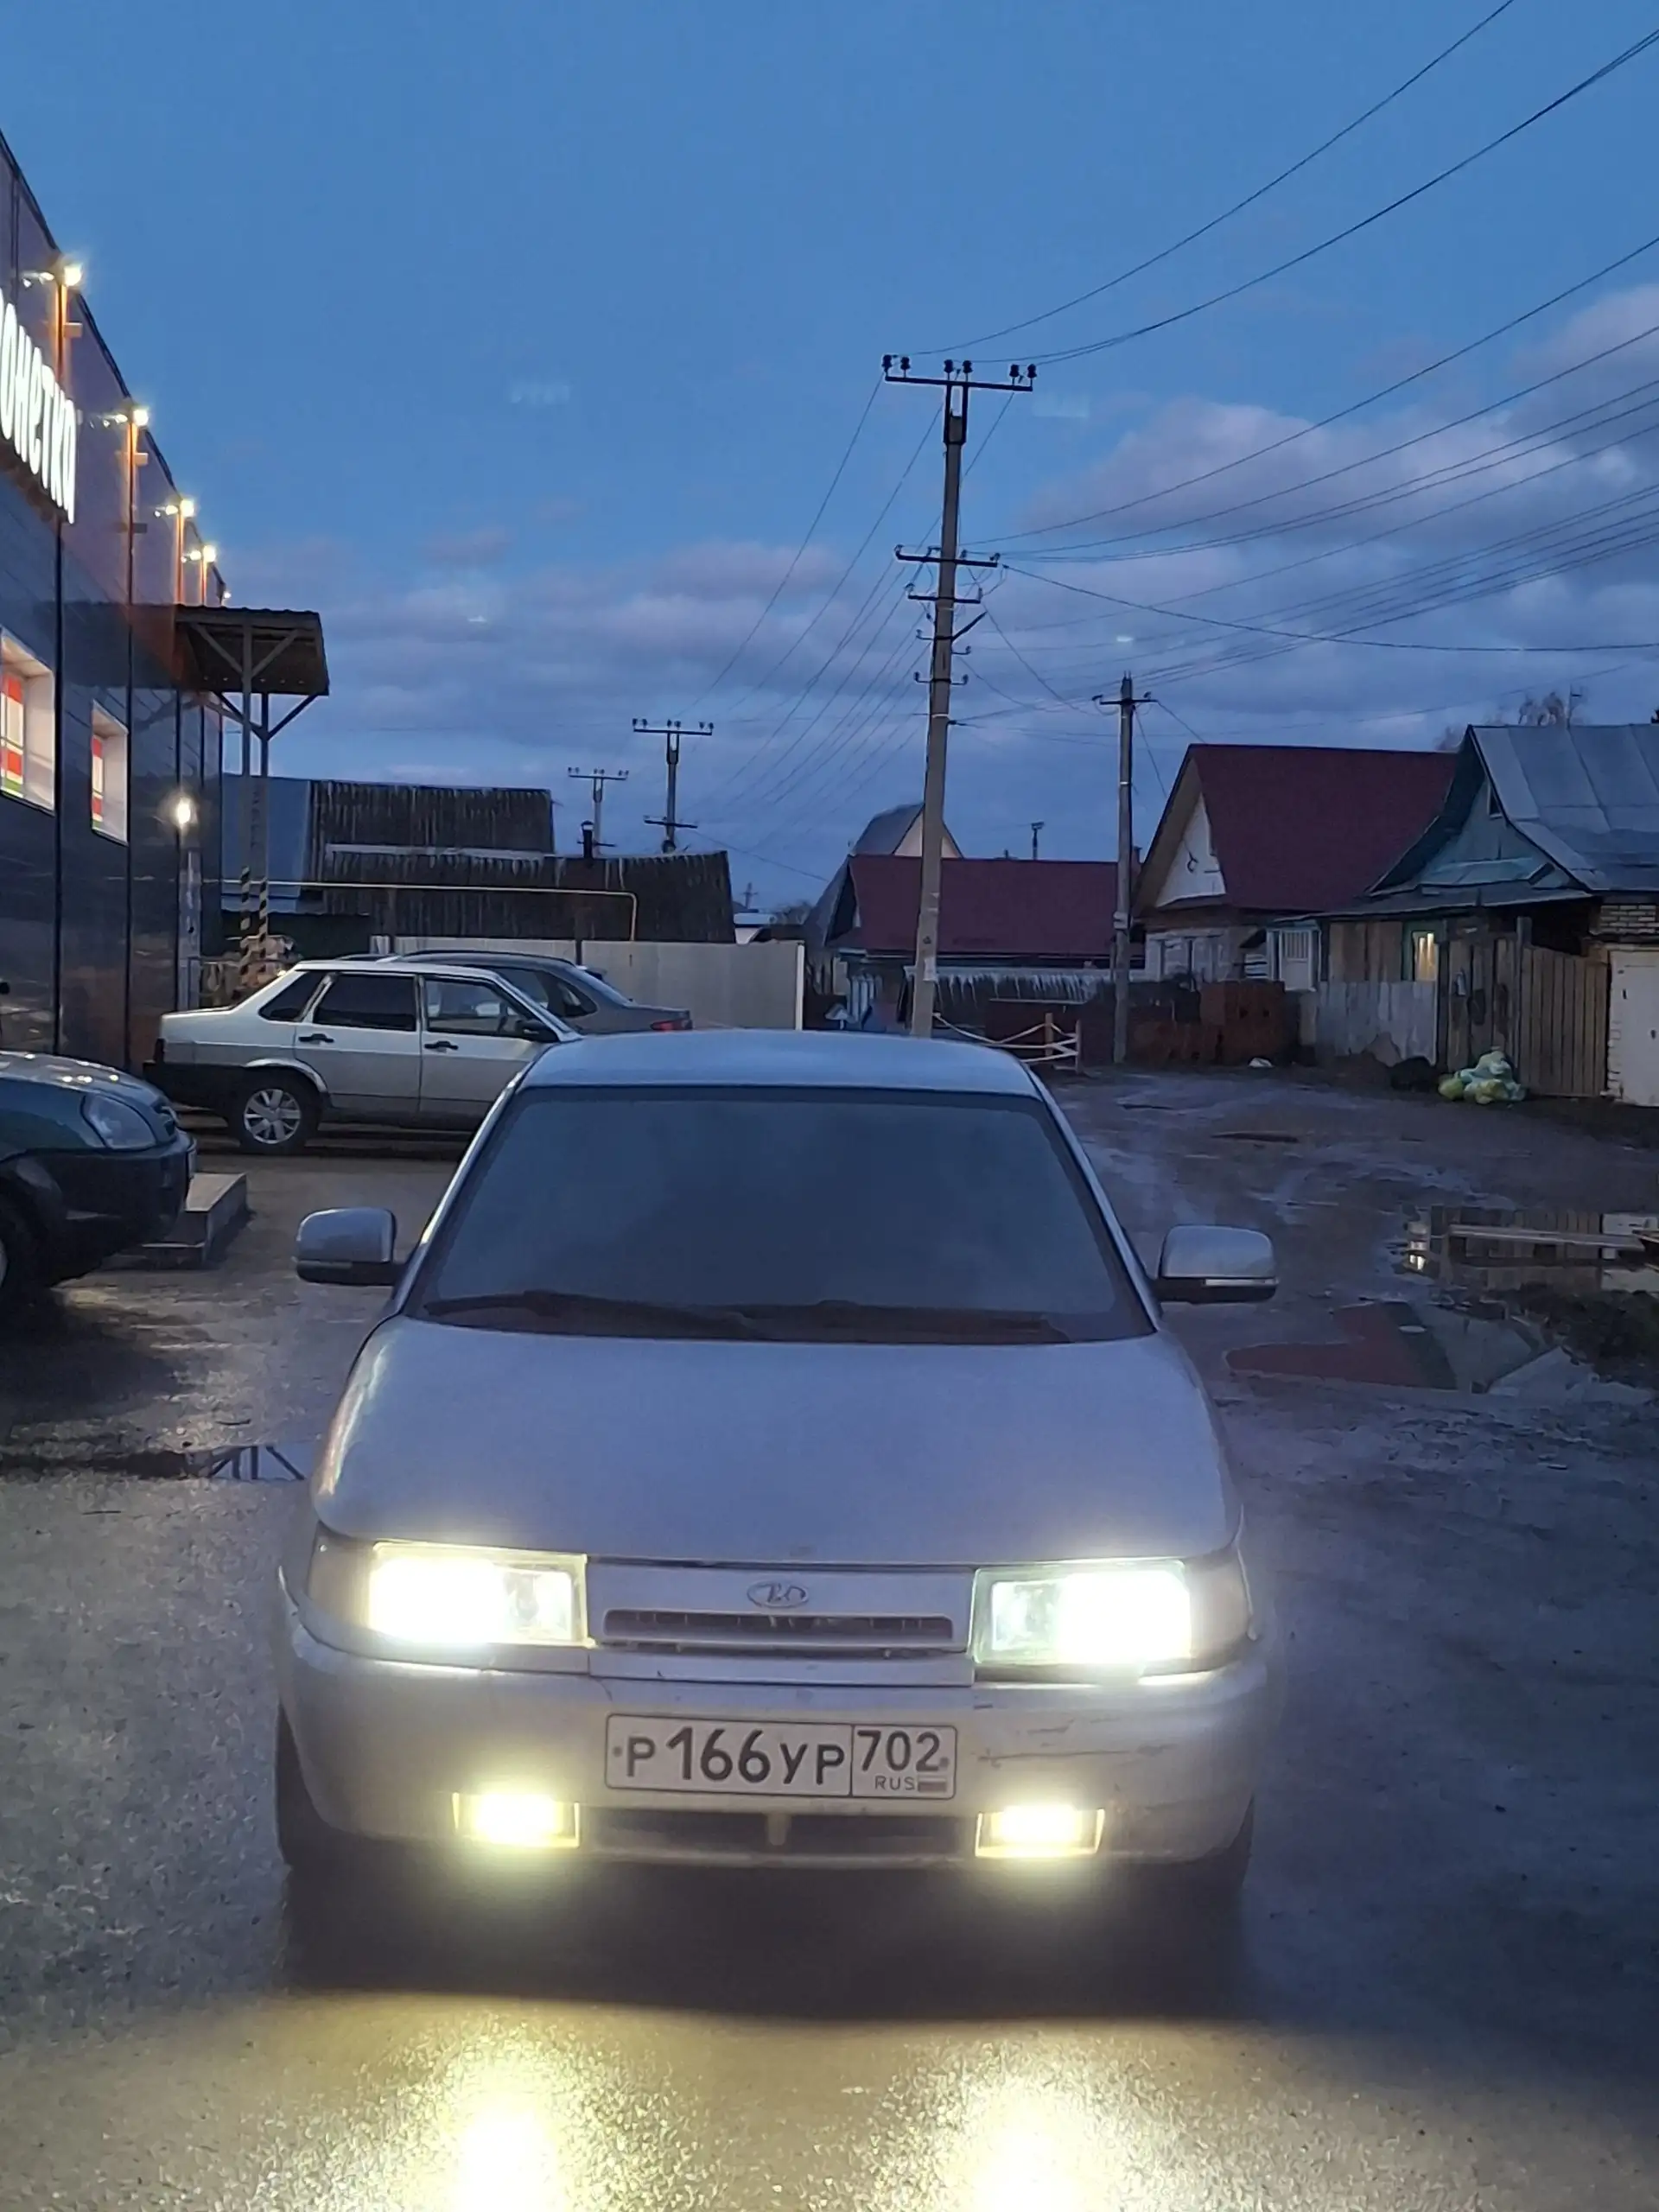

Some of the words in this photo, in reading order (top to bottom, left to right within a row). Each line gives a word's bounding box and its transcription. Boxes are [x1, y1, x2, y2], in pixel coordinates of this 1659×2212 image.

[0, 286, 76, 524] онетка
[857, 1730, 941, 1772] 702
[874, 1775, 915, 1790] RUS
